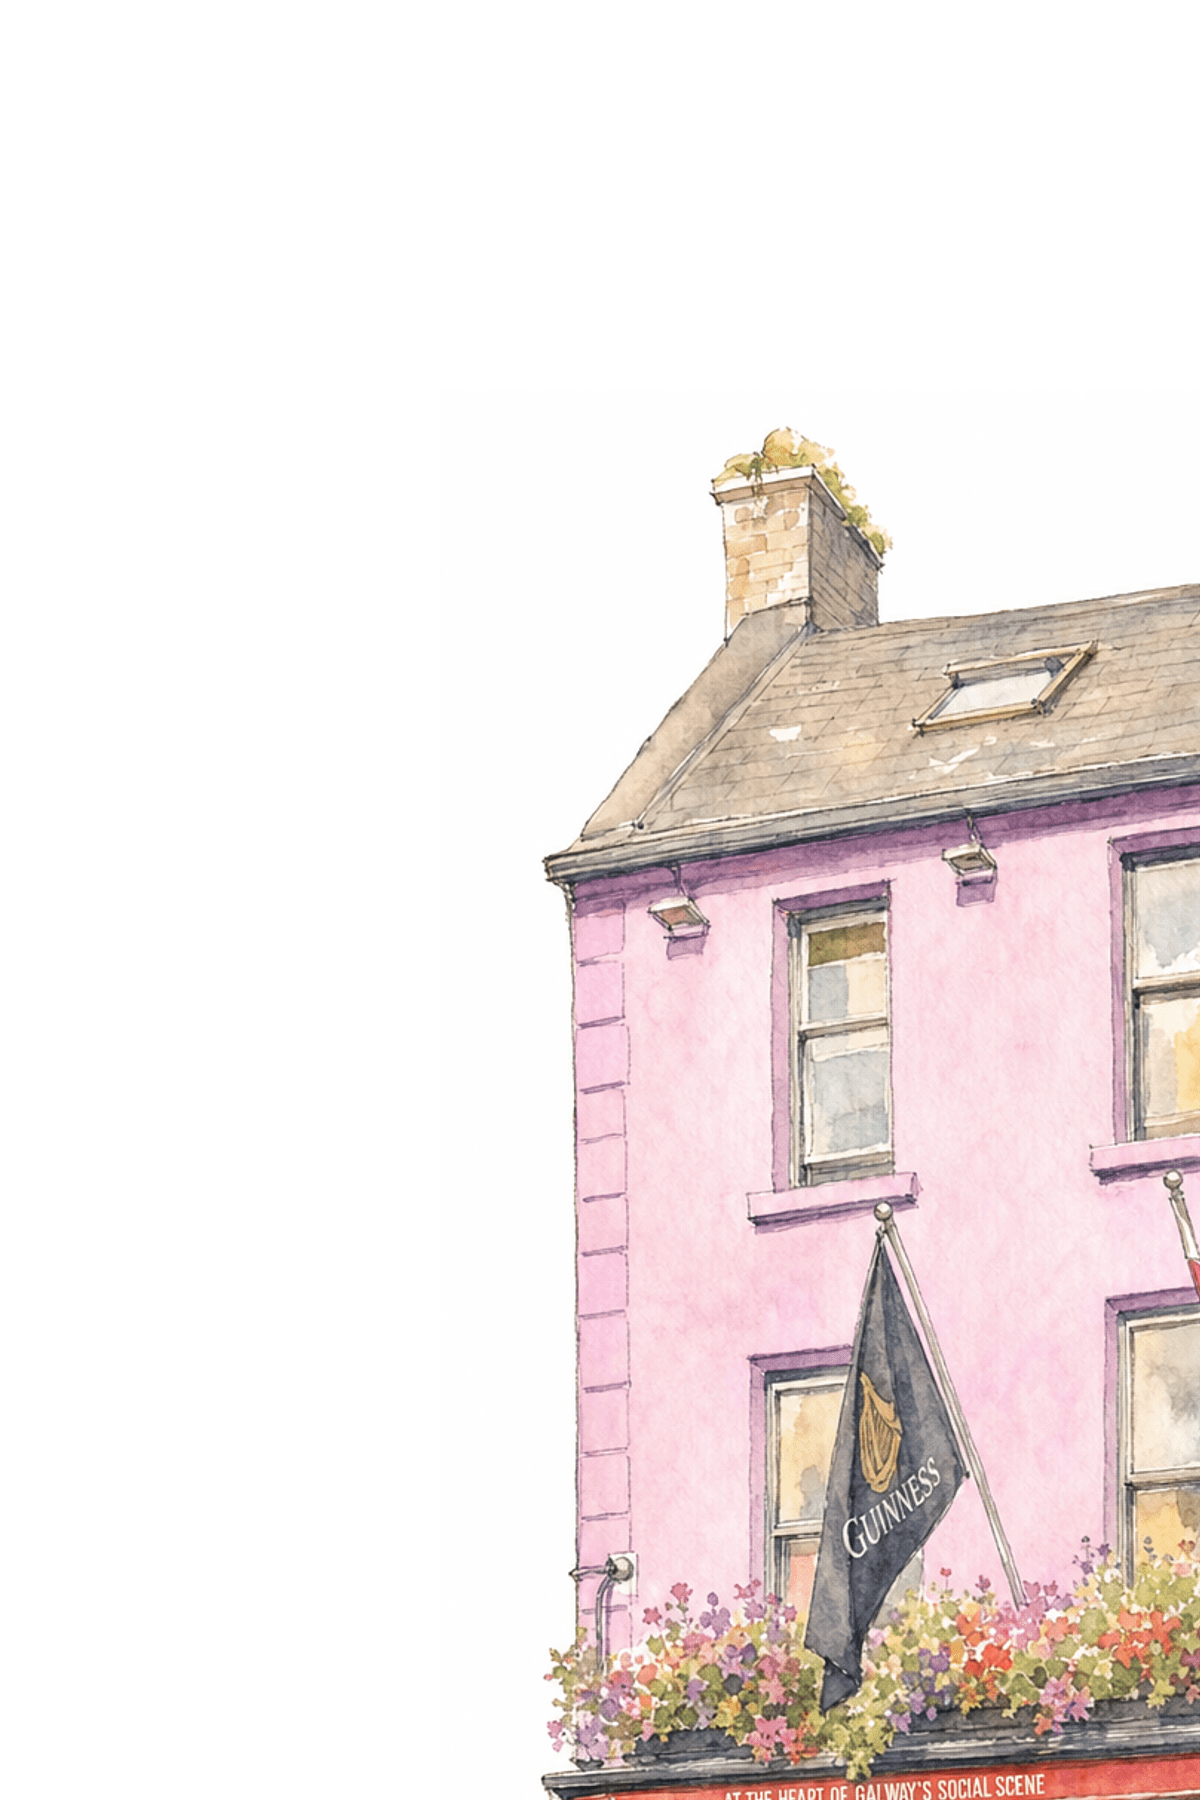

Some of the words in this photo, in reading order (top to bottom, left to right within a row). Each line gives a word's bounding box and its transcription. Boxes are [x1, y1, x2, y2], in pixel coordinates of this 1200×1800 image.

[843, 1457, 940, 1558] GUINNESS
[938, 1776, 992, 1800] SOCIAL
[995, 1774, 1045, 1796] SCENE
